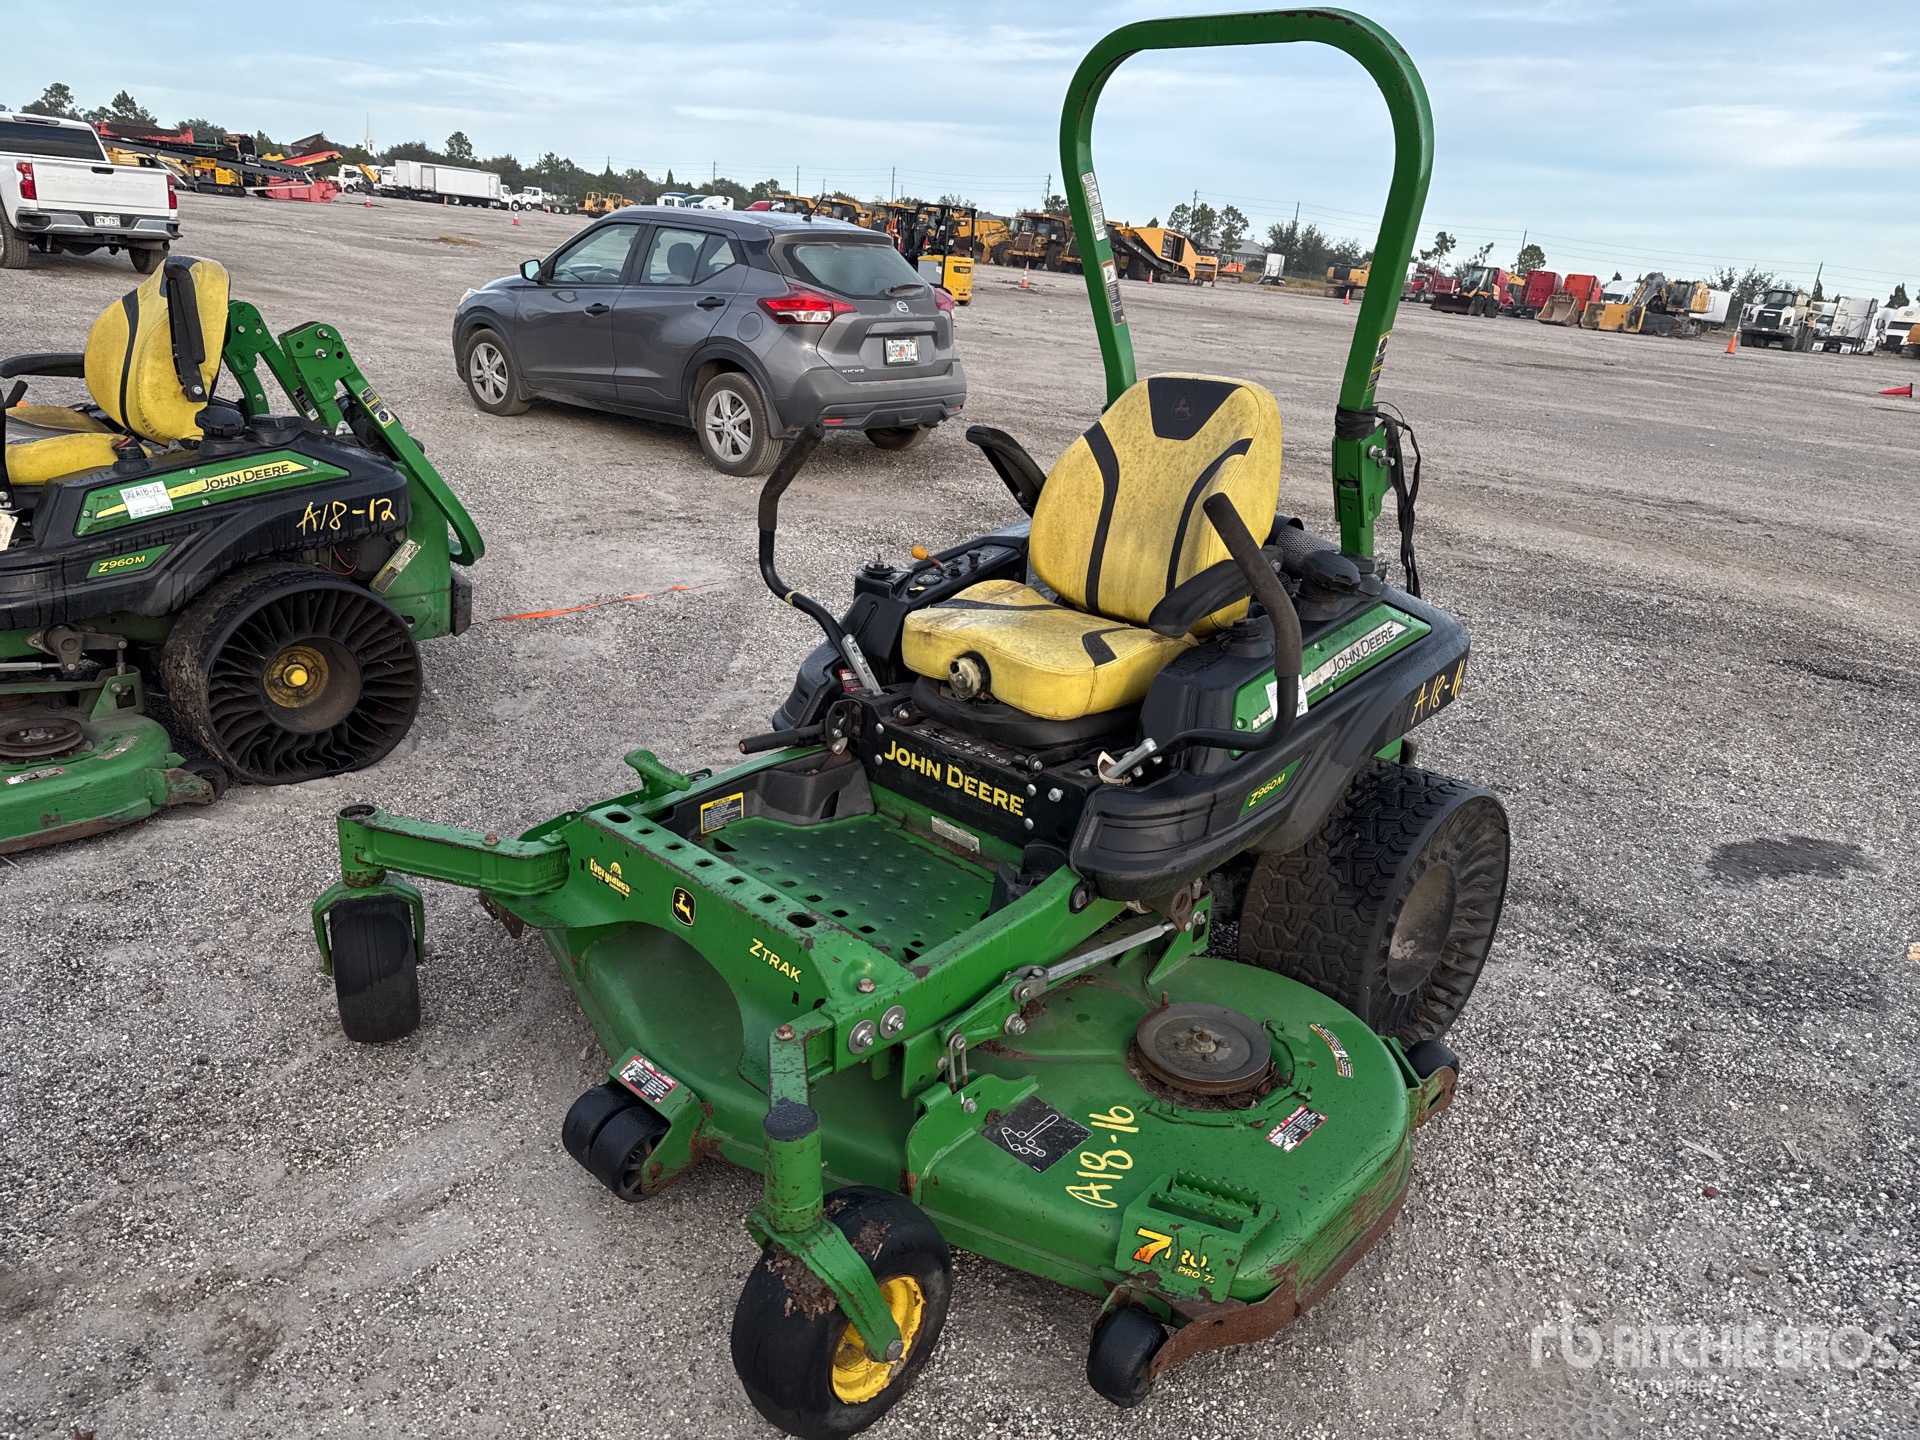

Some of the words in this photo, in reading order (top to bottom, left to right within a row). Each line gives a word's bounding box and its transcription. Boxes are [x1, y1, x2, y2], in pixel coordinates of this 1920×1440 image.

[202, 473, 241, 493] JOHN
[242, 463, 291, 484] DEERE
[296, 497, 396, 536] A18-12
[98, 553, 147, 574] Z960M
[1331, 646, 1361, 674] JOHN
[1361, 625, 1396, 653] DEERE
[884, 740, 942, 782] JOHN
[946, 763, 1025, 817] DEERE
[1248, 772, 1287, 808] Z960M
[748, 937, 803, 985] ZTRAK
[1177, 1265, 1201, 1279] PRO
